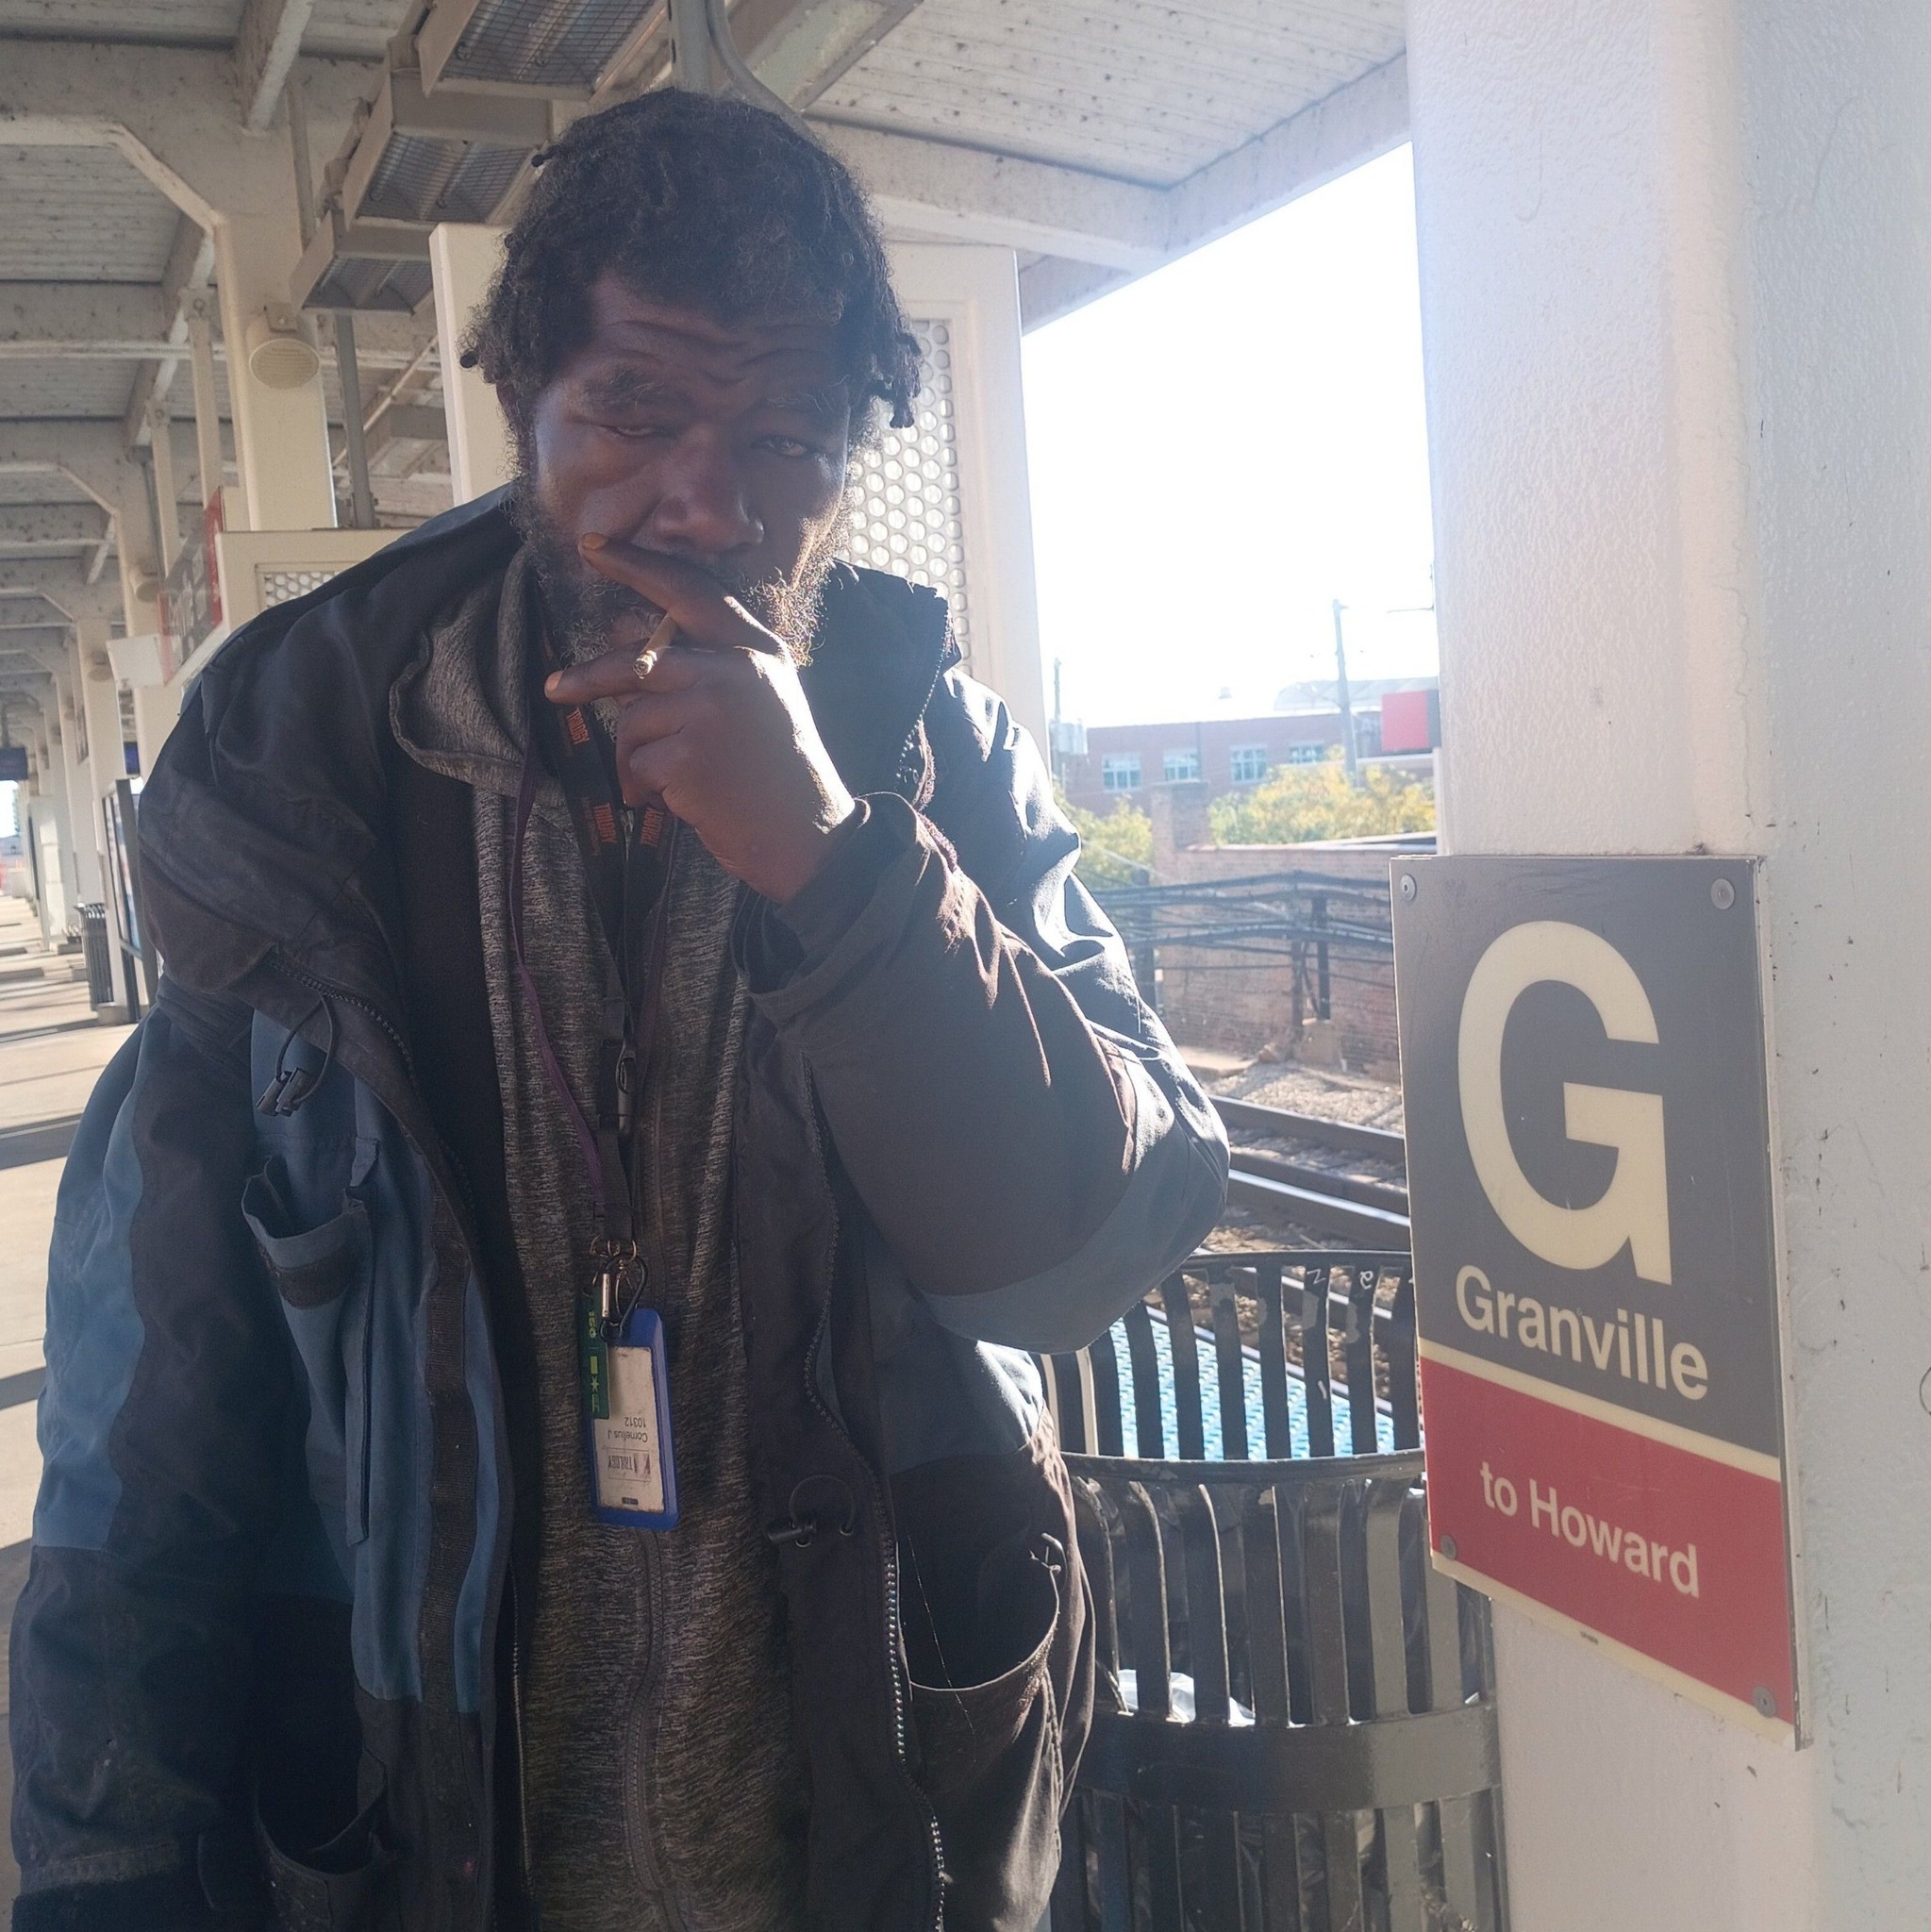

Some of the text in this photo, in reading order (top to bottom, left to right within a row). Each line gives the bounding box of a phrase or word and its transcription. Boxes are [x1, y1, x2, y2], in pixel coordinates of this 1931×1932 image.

[567, 707, 590, 744] TRILOGY
[1457, 920, 1672, 1285] G
[1455, 1263, 1709, 1401] Granville
[608, 1430, 647, 1442] Cornelius J
[624, 1417, 646, 1427] 10312
[608, 1455, 633, 1470] TRILOGY
[1480, 1459, 1699, 1600] to Howard
